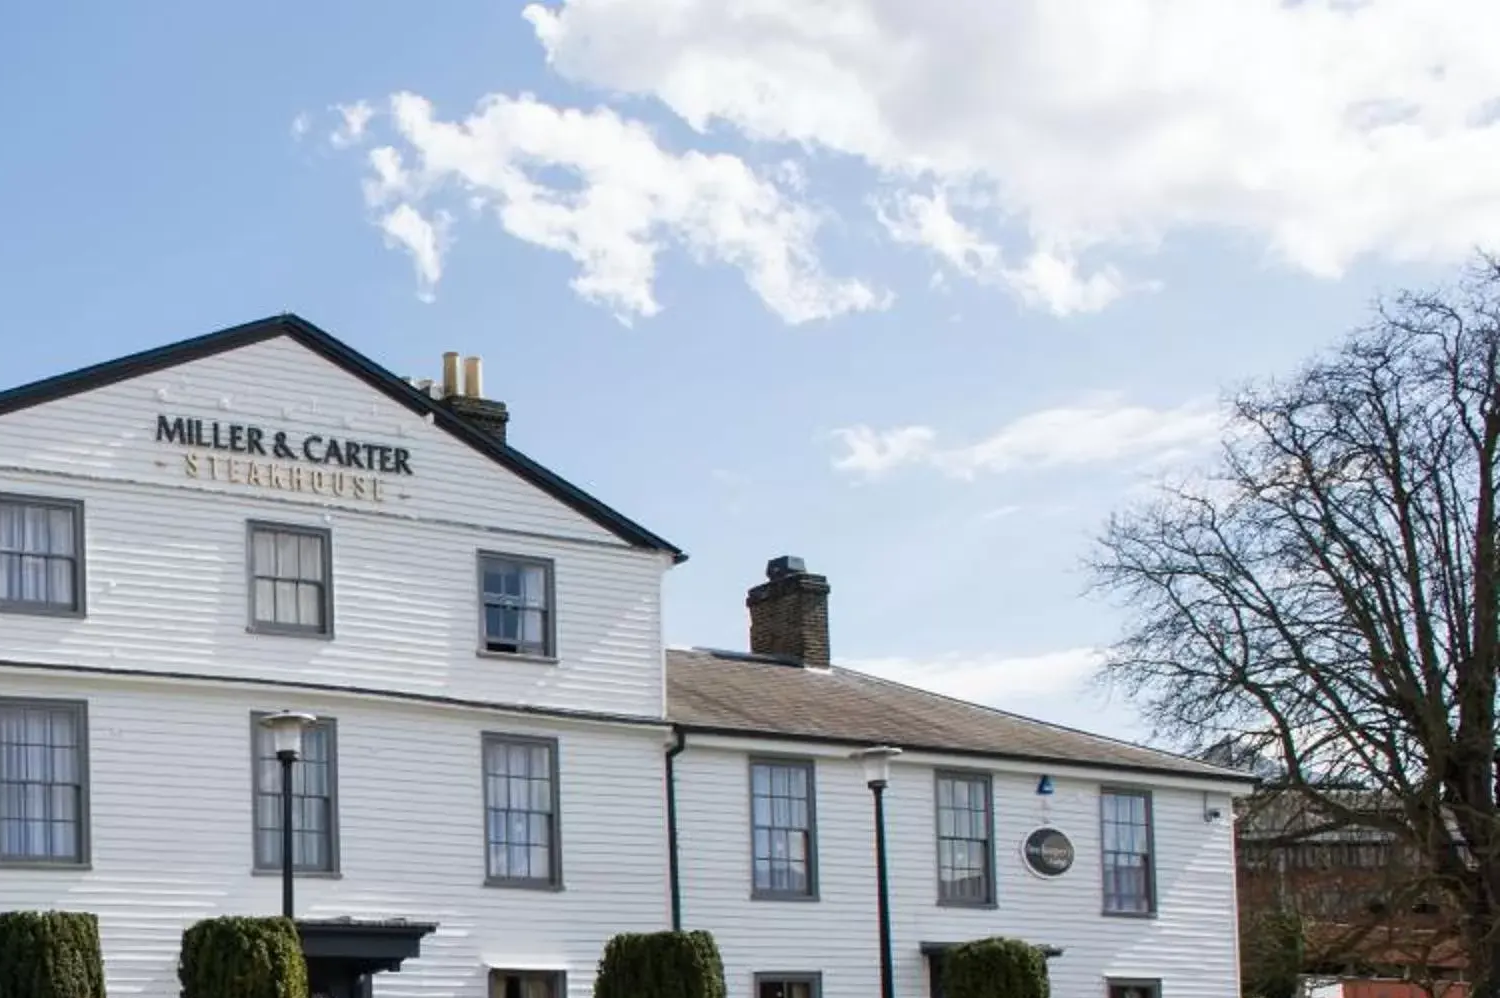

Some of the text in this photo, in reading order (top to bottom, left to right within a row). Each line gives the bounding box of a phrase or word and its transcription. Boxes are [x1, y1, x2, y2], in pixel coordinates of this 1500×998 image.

[156, 415, 413, 475] MILLER & CARTER
[184, 453, 385, 501] STEAKHOUSE
